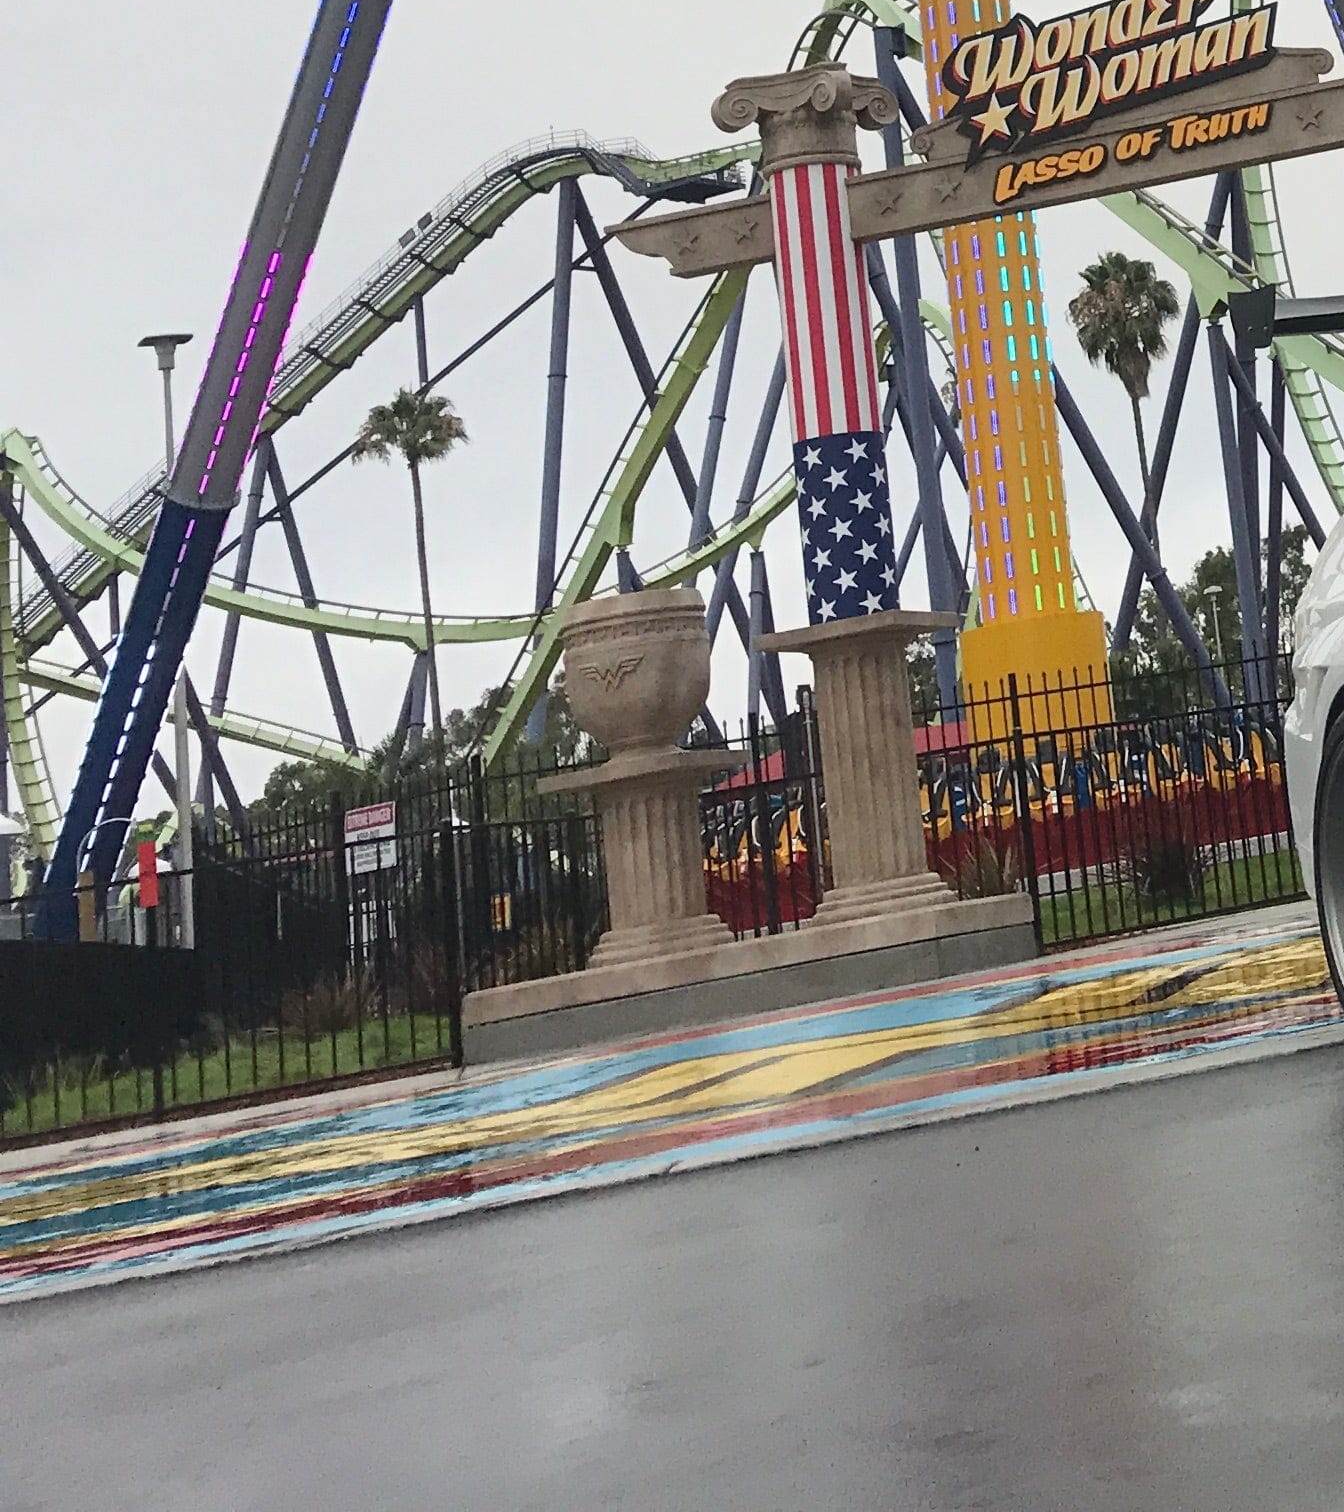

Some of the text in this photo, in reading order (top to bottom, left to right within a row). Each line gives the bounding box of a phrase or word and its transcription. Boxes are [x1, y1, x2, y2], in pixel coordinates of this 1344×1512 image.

[1018, 8, 1270, 136] Woman
[993, 102, 1270, 204] LASSO OF TRUTH
